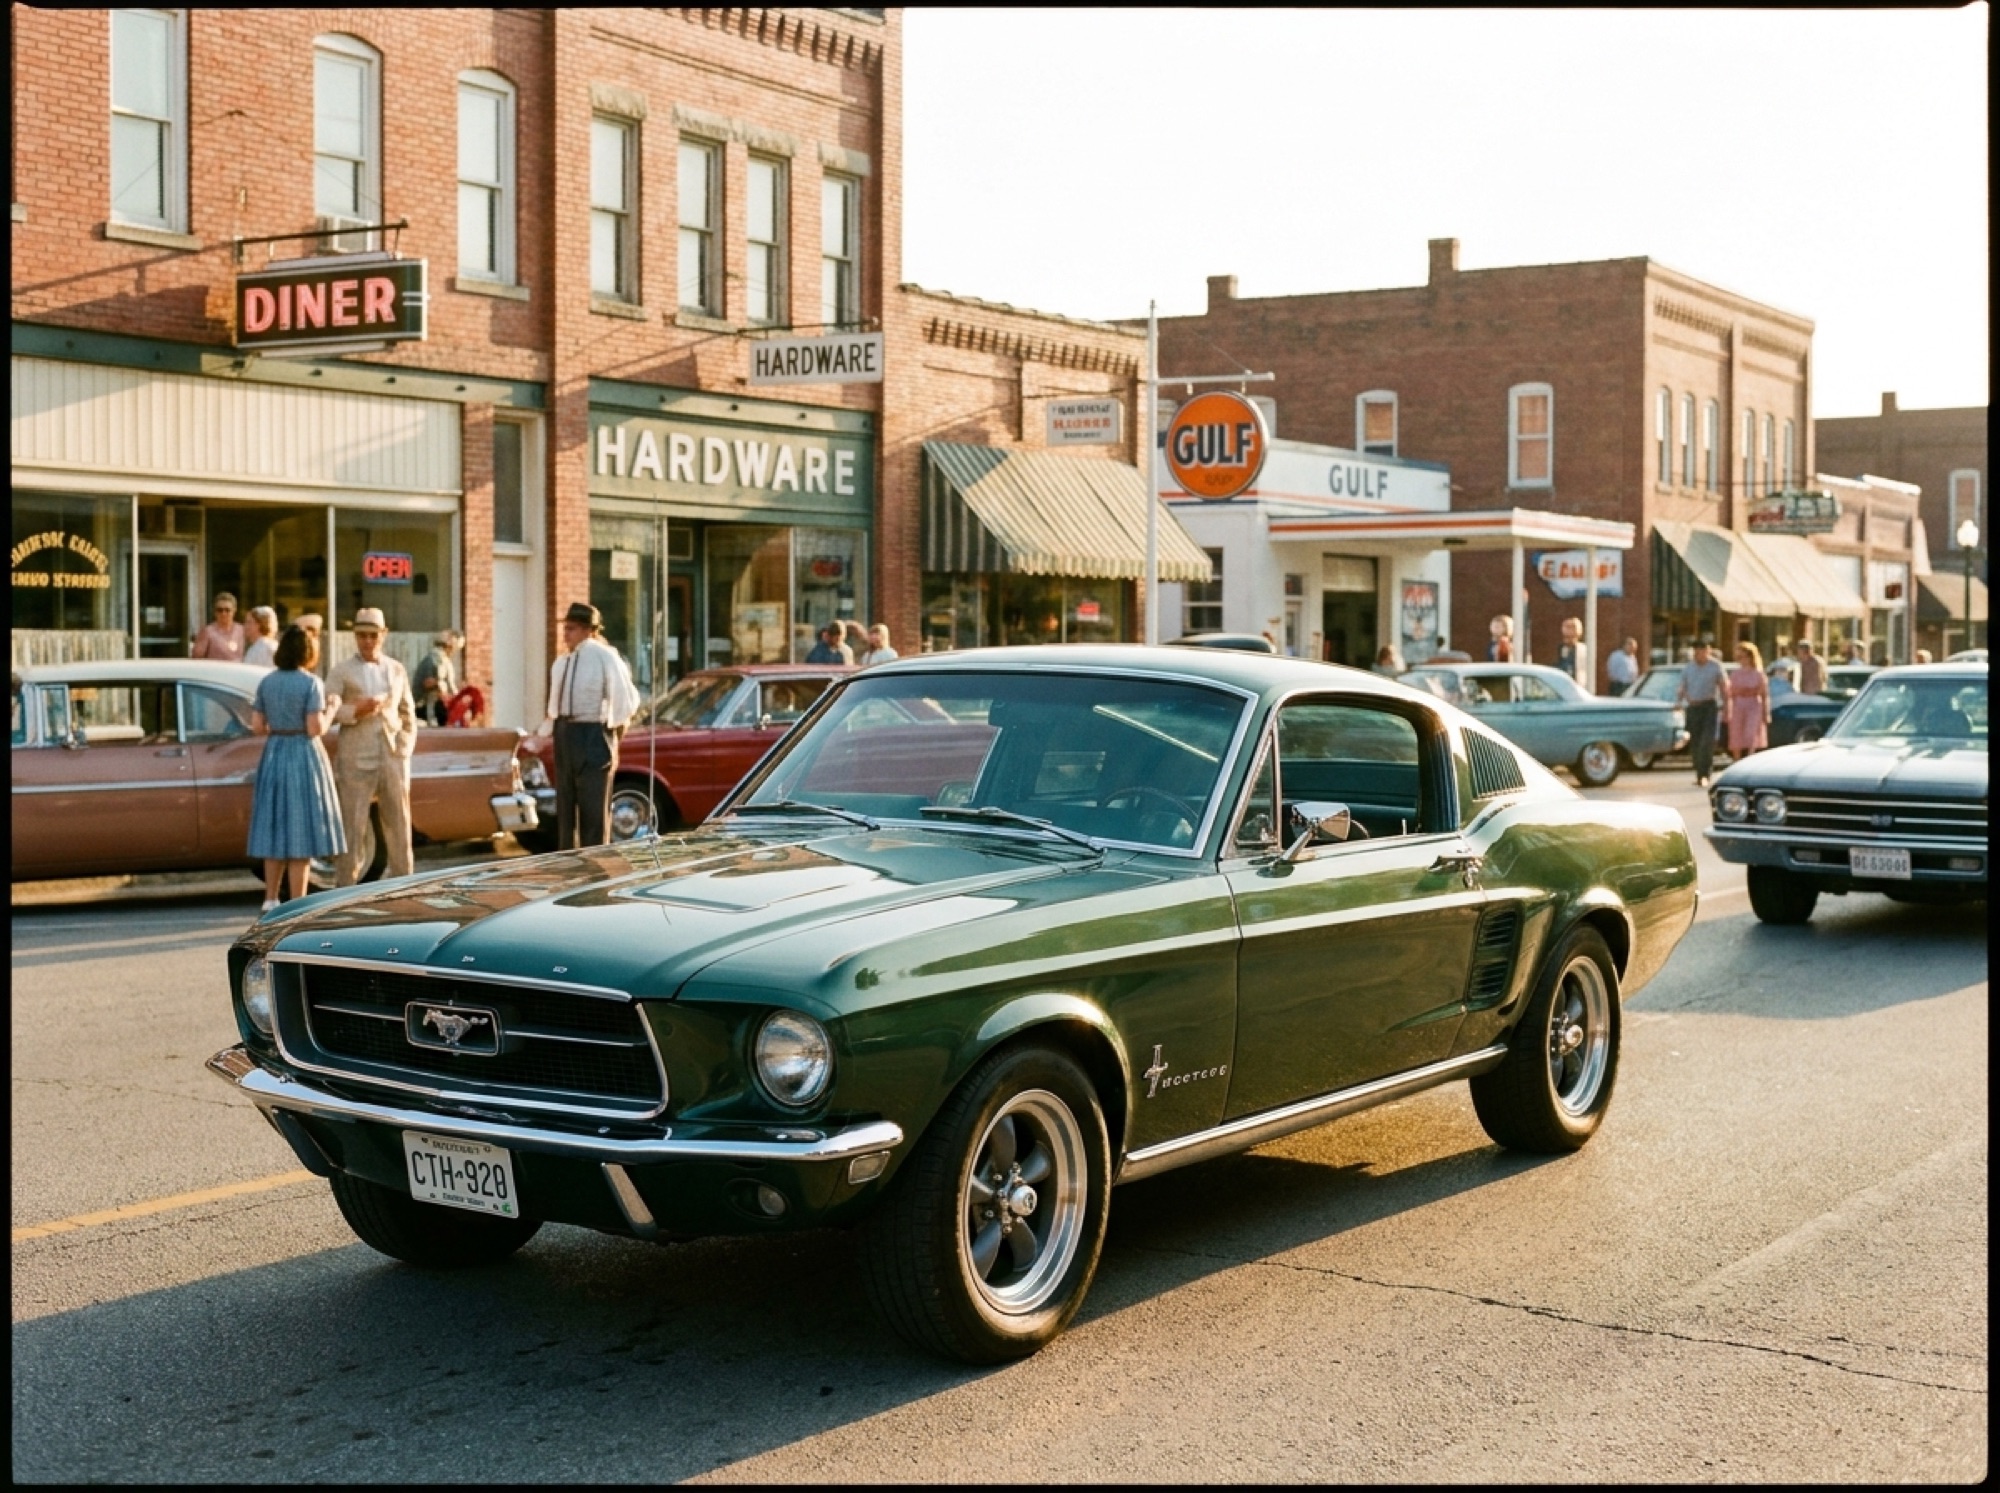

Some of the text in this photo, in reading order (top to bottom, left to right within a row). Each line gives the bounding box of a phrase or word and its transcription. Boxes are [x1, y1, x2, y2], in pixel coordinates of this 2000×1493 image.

[244, 276, 396, 333] DINER
[756, 342, 877, 377] HARDWARE
[597, 424, 856, 495] HARDWARE
[1173, 422, 1256, 468] GULF
[1329, 464, 1388, 499] GULF
[364, 556, 412, 579] OPEN
